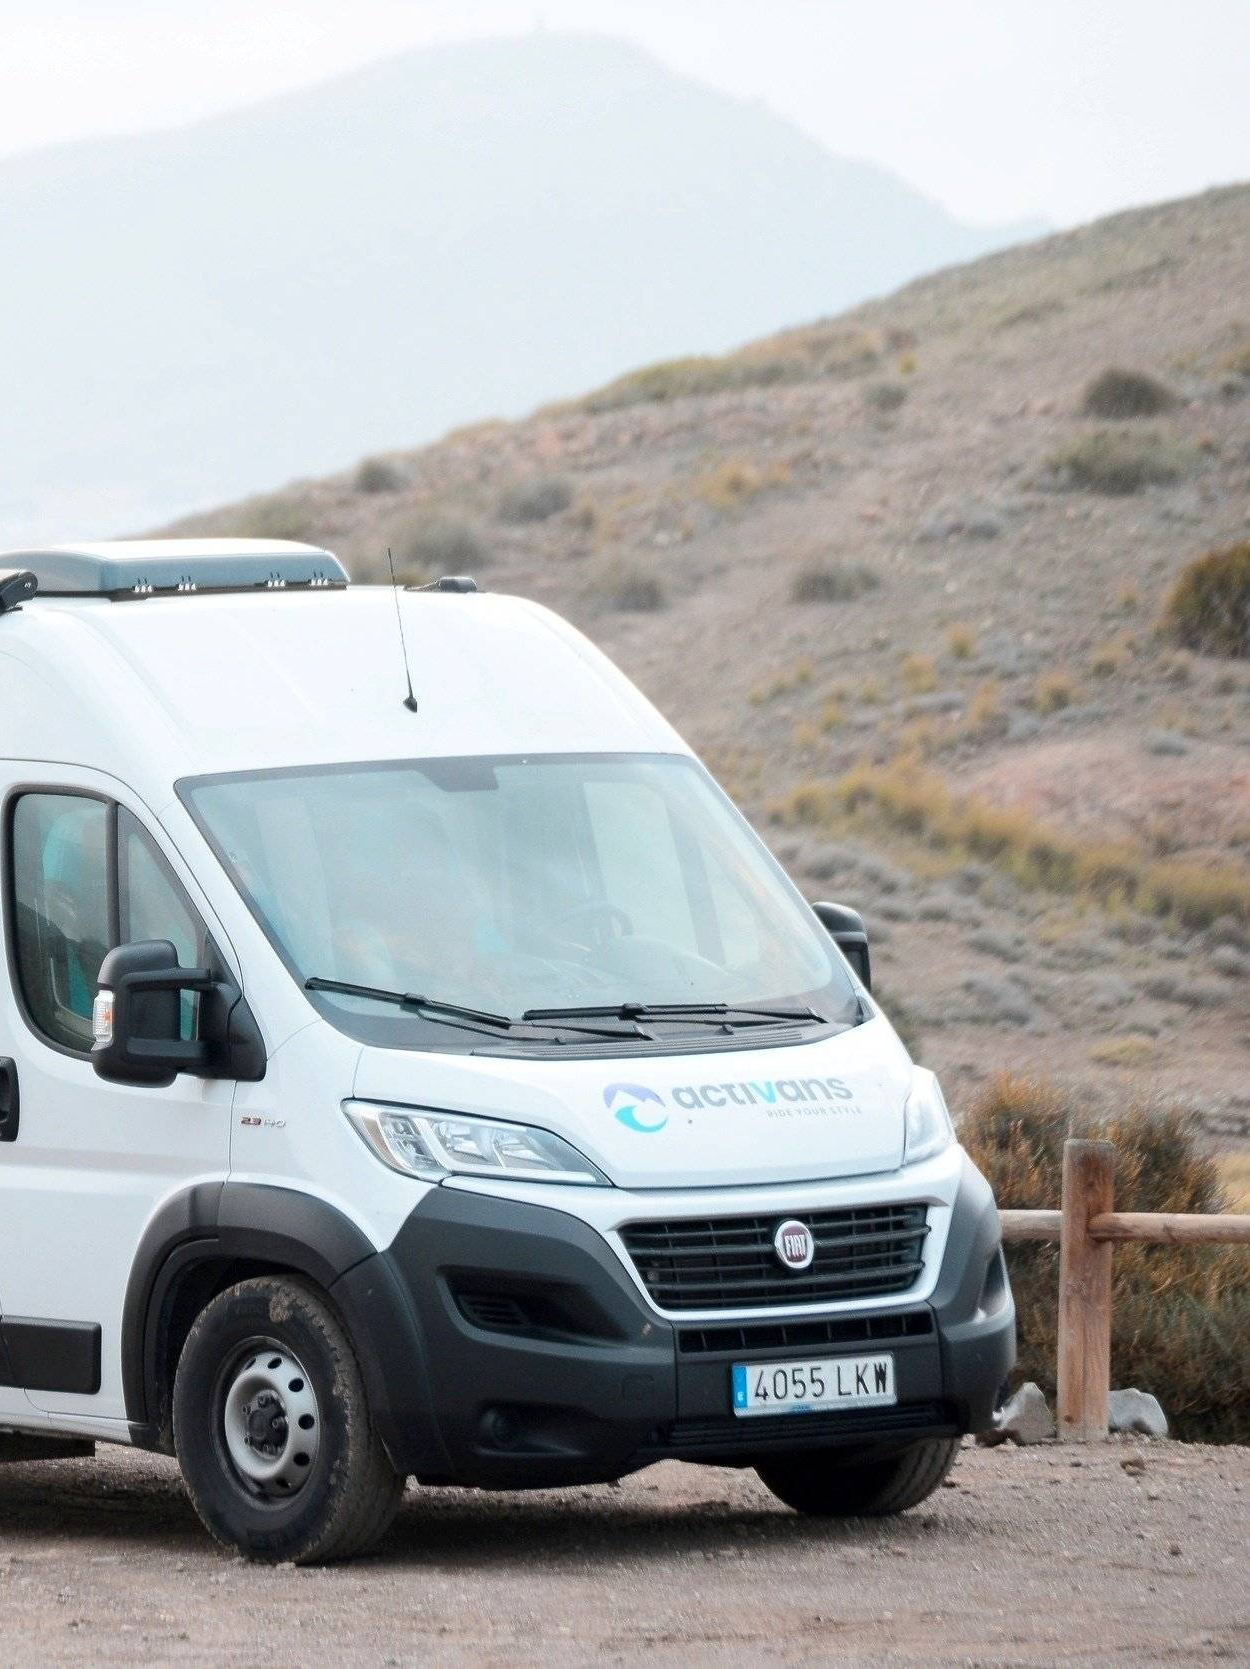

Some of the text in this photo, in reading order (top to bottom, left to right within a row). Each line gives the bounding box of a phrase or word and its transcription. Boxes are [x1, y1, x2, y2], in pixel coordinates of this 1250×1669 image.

[796, 1107, 827, 1116] YOUR
[784, 1234, 806, 1257] FIAT
[754, 1362, 888, 1401] 4055 LKW
